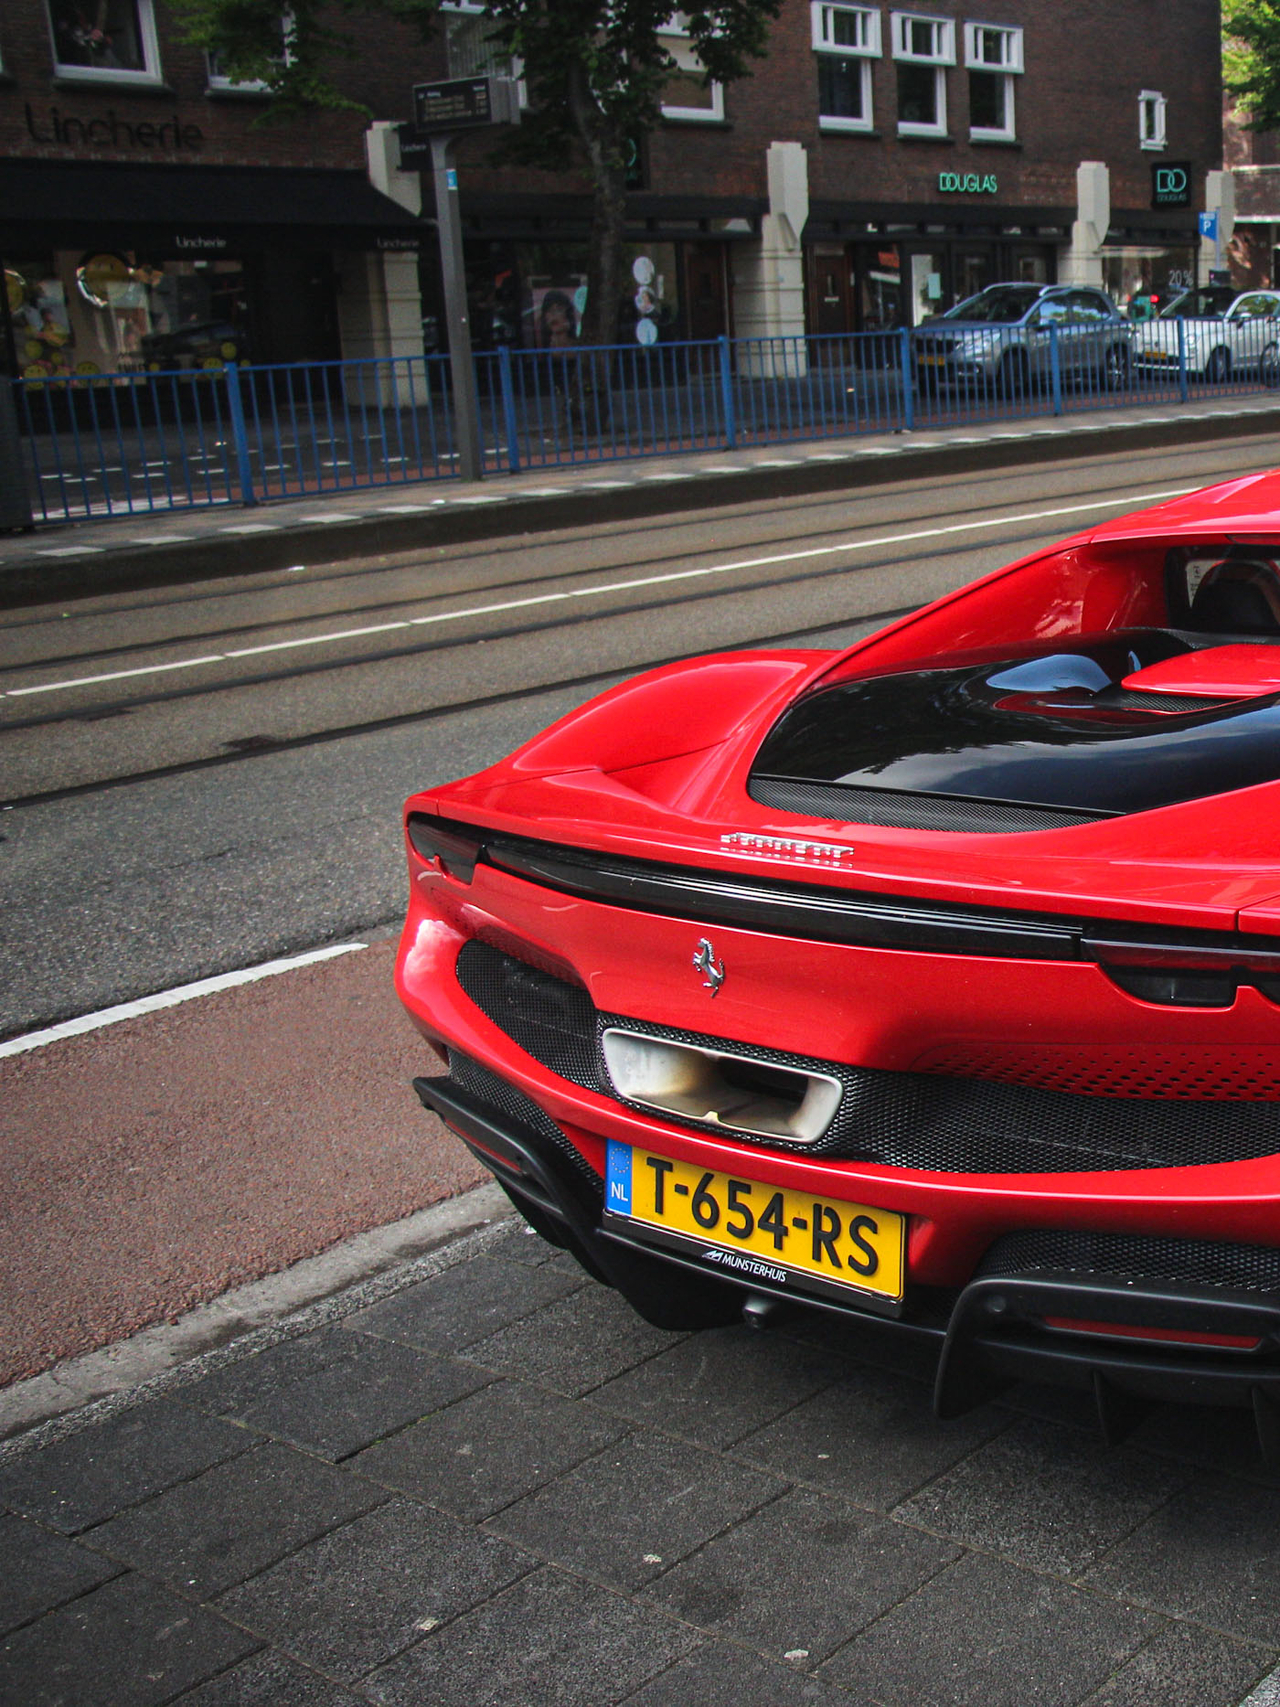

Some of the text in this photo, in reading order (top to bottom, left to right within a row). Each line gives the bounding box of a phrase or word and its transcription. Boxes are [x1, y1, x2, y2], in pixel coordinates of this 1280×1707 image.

[25, 102, 204, 149] Lincherie
[939, 172, 998, 193] DOUGLAS
[1203, 220, 1212, 233] P
[176, 236, 226, 248] Lincherie
[610, 1182, 629, 1202] NL
[646, 1156, 879, 1277] T-654-RS
[721, 1253, 787, 1283] MUNSTERHUIS
